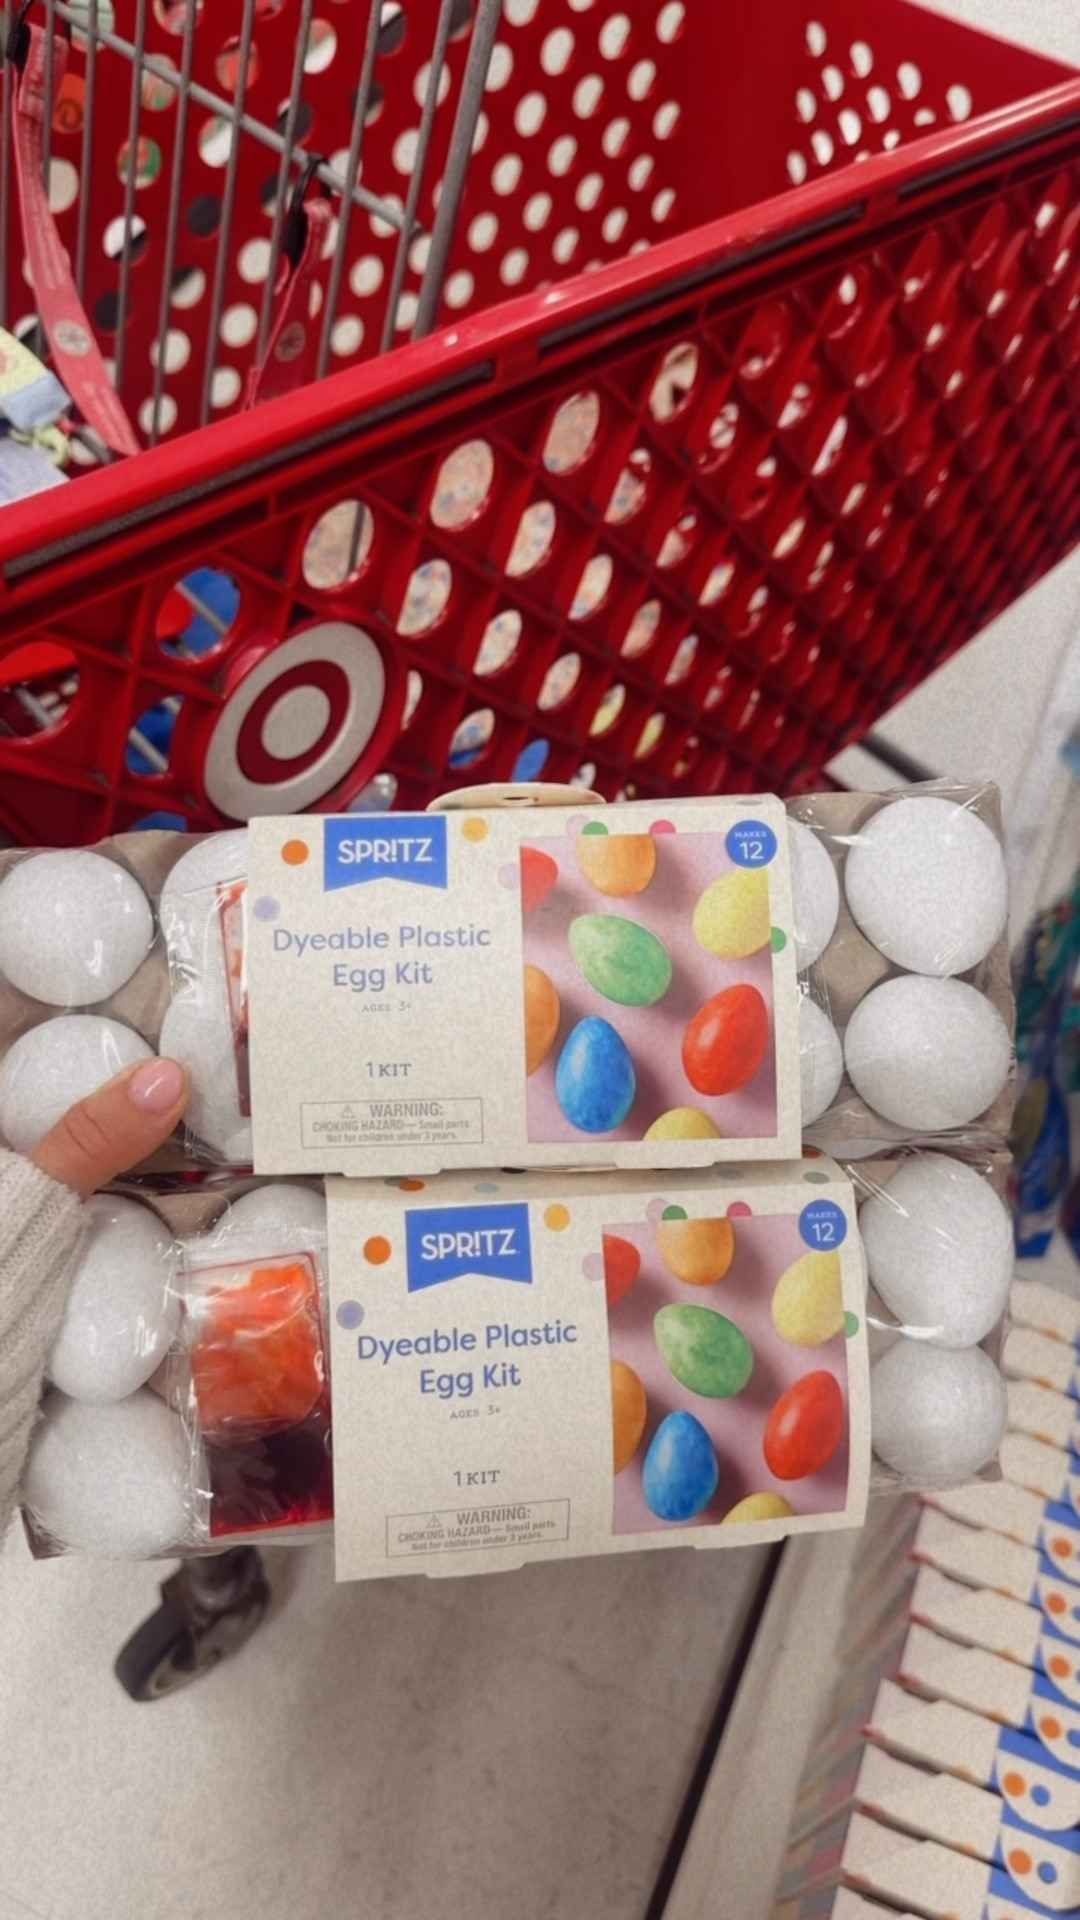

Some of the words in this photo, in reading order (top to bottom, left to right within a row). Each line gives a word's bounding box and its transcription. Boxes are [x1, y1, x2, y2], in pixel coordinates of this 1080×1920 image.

[739, 841, 765, 860] 12
[273, 927, 390, 957] Dyeable
[399, 924, 491, 948] Plastic
[333, 964, 385, 993] Egg
[395, 962, 433, 985] Kit
[362, 1004, 391, 1012] AGES
[398, 1001, 412, 1011] 3+
[366, 1063, 373, 1077] 1
[378, 1063, 412, 1078] KIT
[370, 1103, 443, 1117] WARNING:
[312, 1121, 359, 1133] CHOKING
[419, 1119, 443, 1129] Small
[812, 1222, 835, 1242] 12
[358, 1328, 476, 1365] Dyeable
[486, 1320, 577, 1348] Plastic
[420, 1369, 473, 1400] Egg
[483, 1363, 521, 1388] Kit
[450, 1409, 480, 1419] AGES
[487, 1405, 501, 1416] 3+
[454, 1471, 462, 1486] 1
[466, 1470, 501, 1485] KIT
[457, 1506, 530, 1525] WARNING:
[398, 1529, 444, 1543] CHOKING
[505, 1521, 530, 1533] Small
[443, 1538, 480, 1548] children
[482, 1535, 507, 1545] under
[509, 1533, 516, 1542] 3
